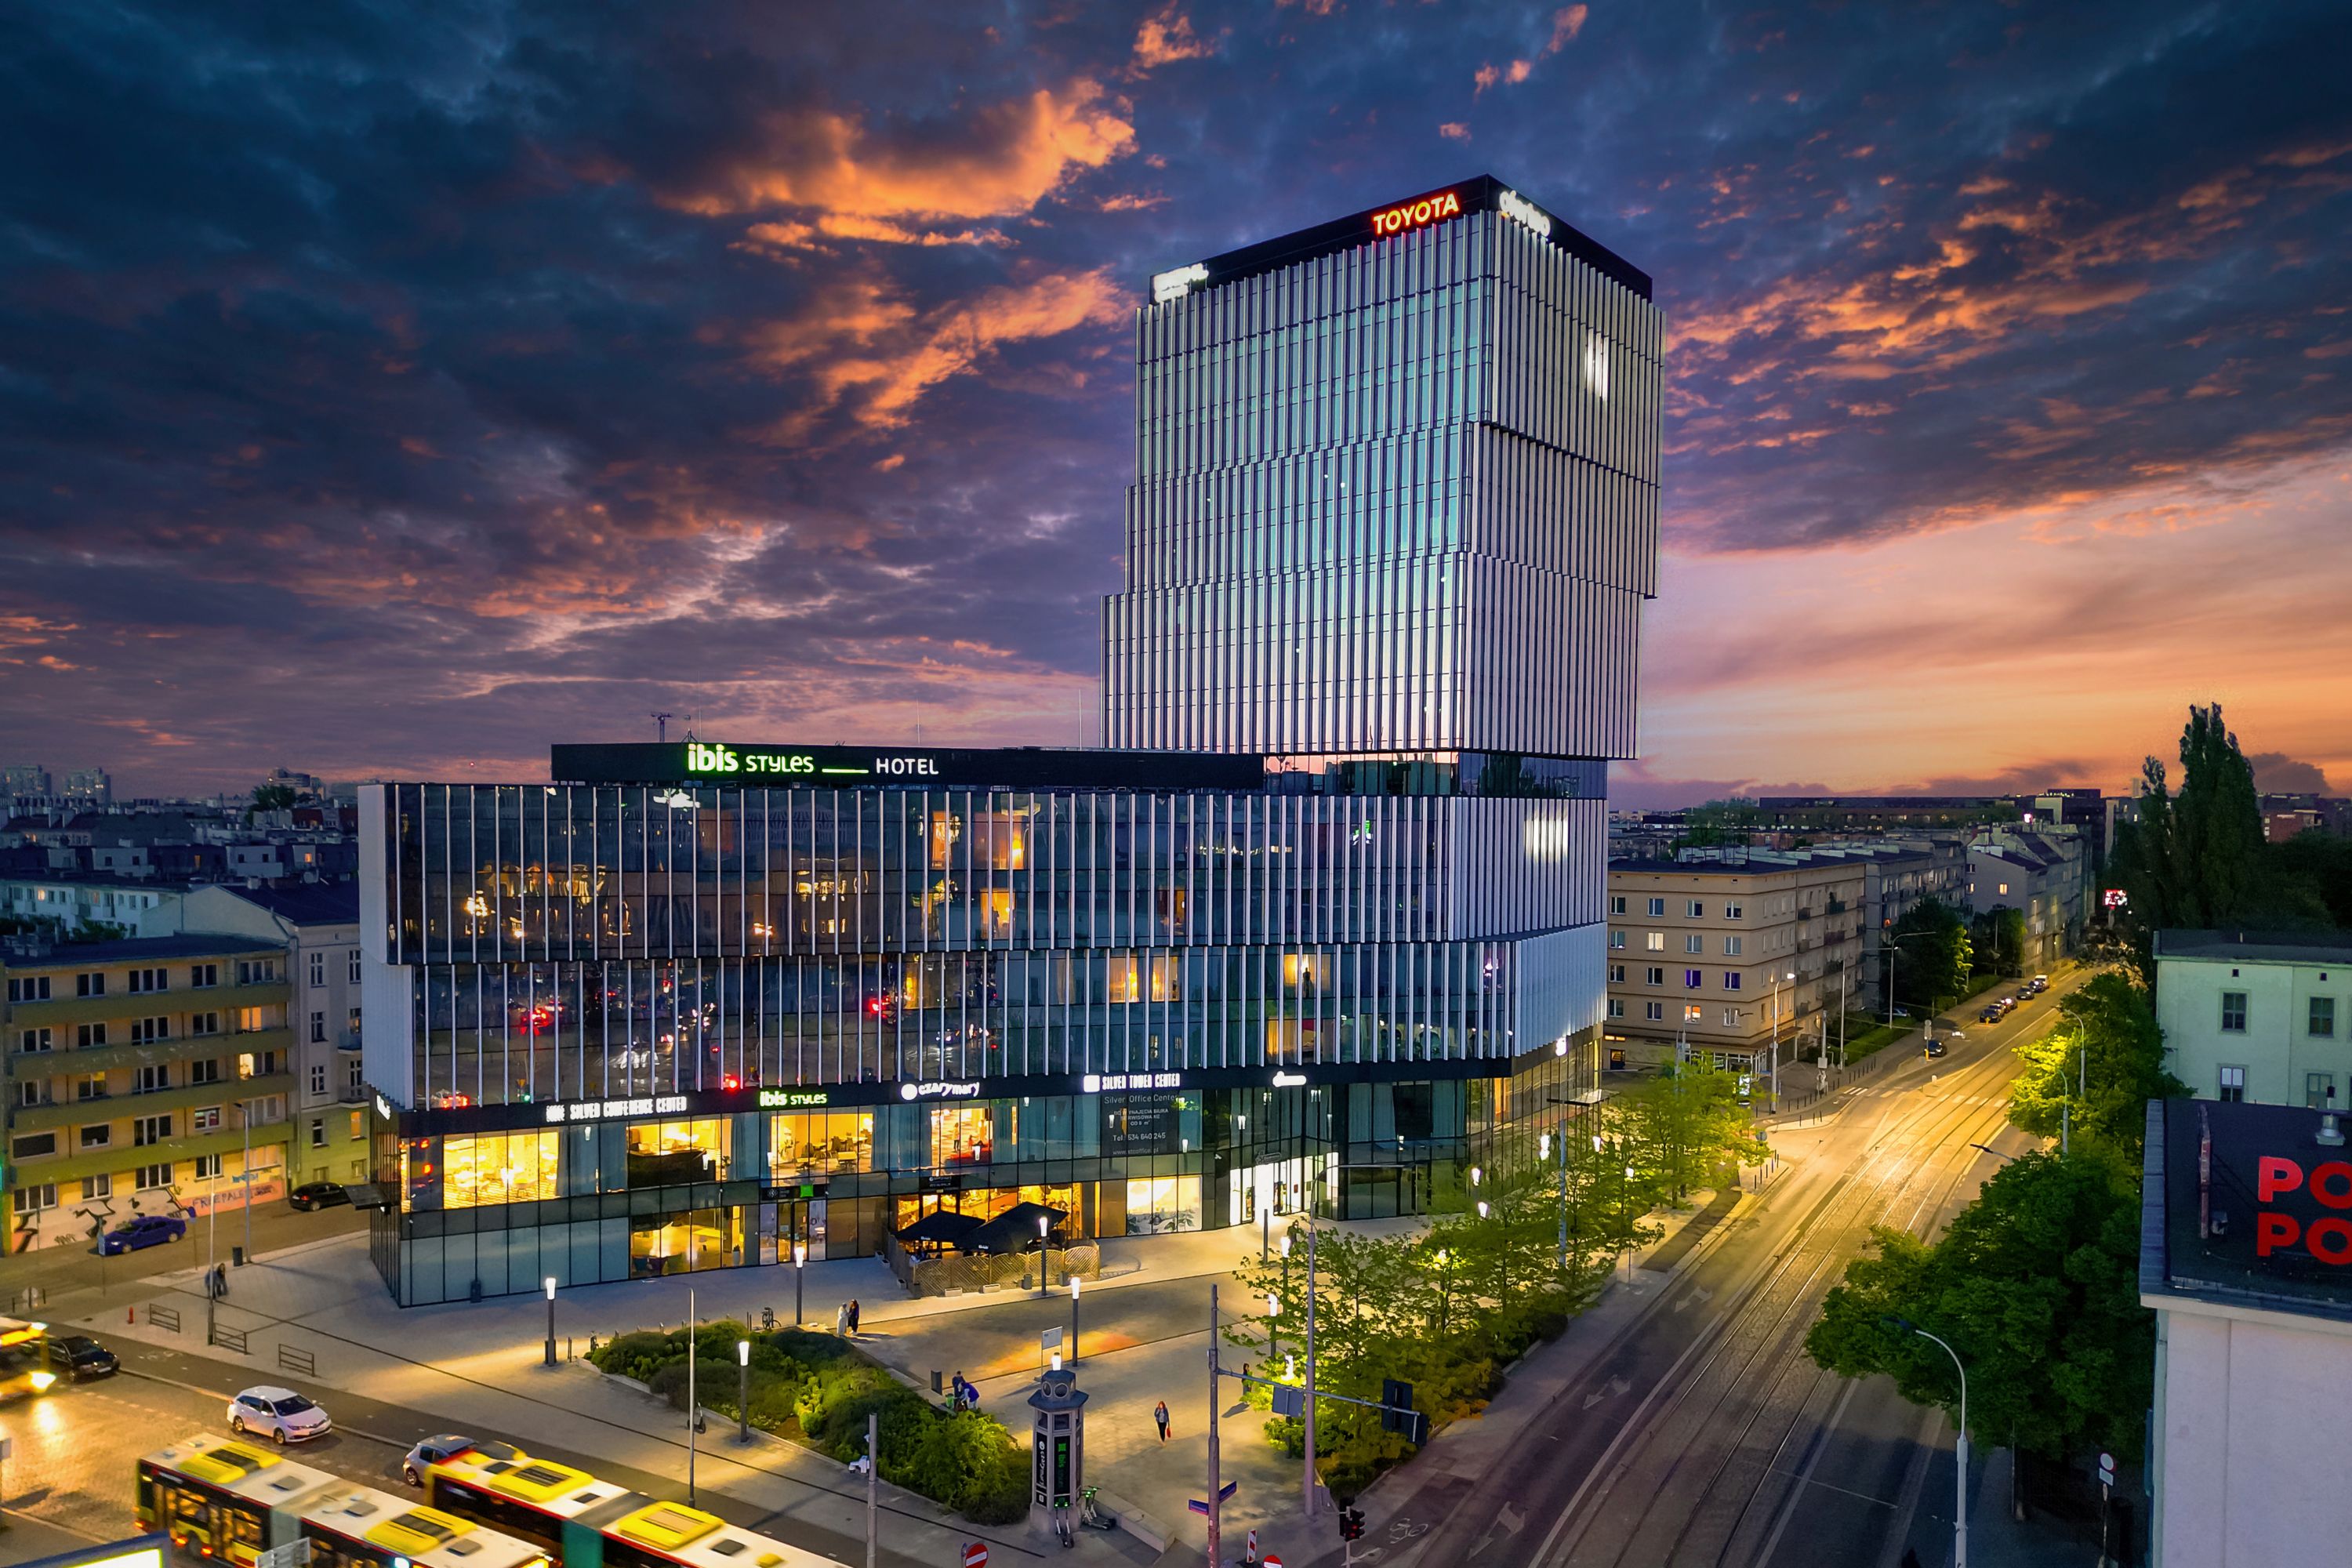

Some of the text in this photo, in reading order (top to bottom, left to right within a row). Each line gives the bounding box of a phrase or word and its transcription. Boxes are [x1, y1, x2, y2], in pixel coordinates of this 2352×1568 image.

[1373, 193, 1459, 234] TOYOTA
[688, 743, 739, 772] ibis
[876, 757, 938, 775] HOTEL
[759, 1091, 787, 1106] ibis
[1129, 1094, 1152, 1103] Office
[2258, 1156, 2352, 1210] PO
[2256, 1212, 2352, 1265] PO
